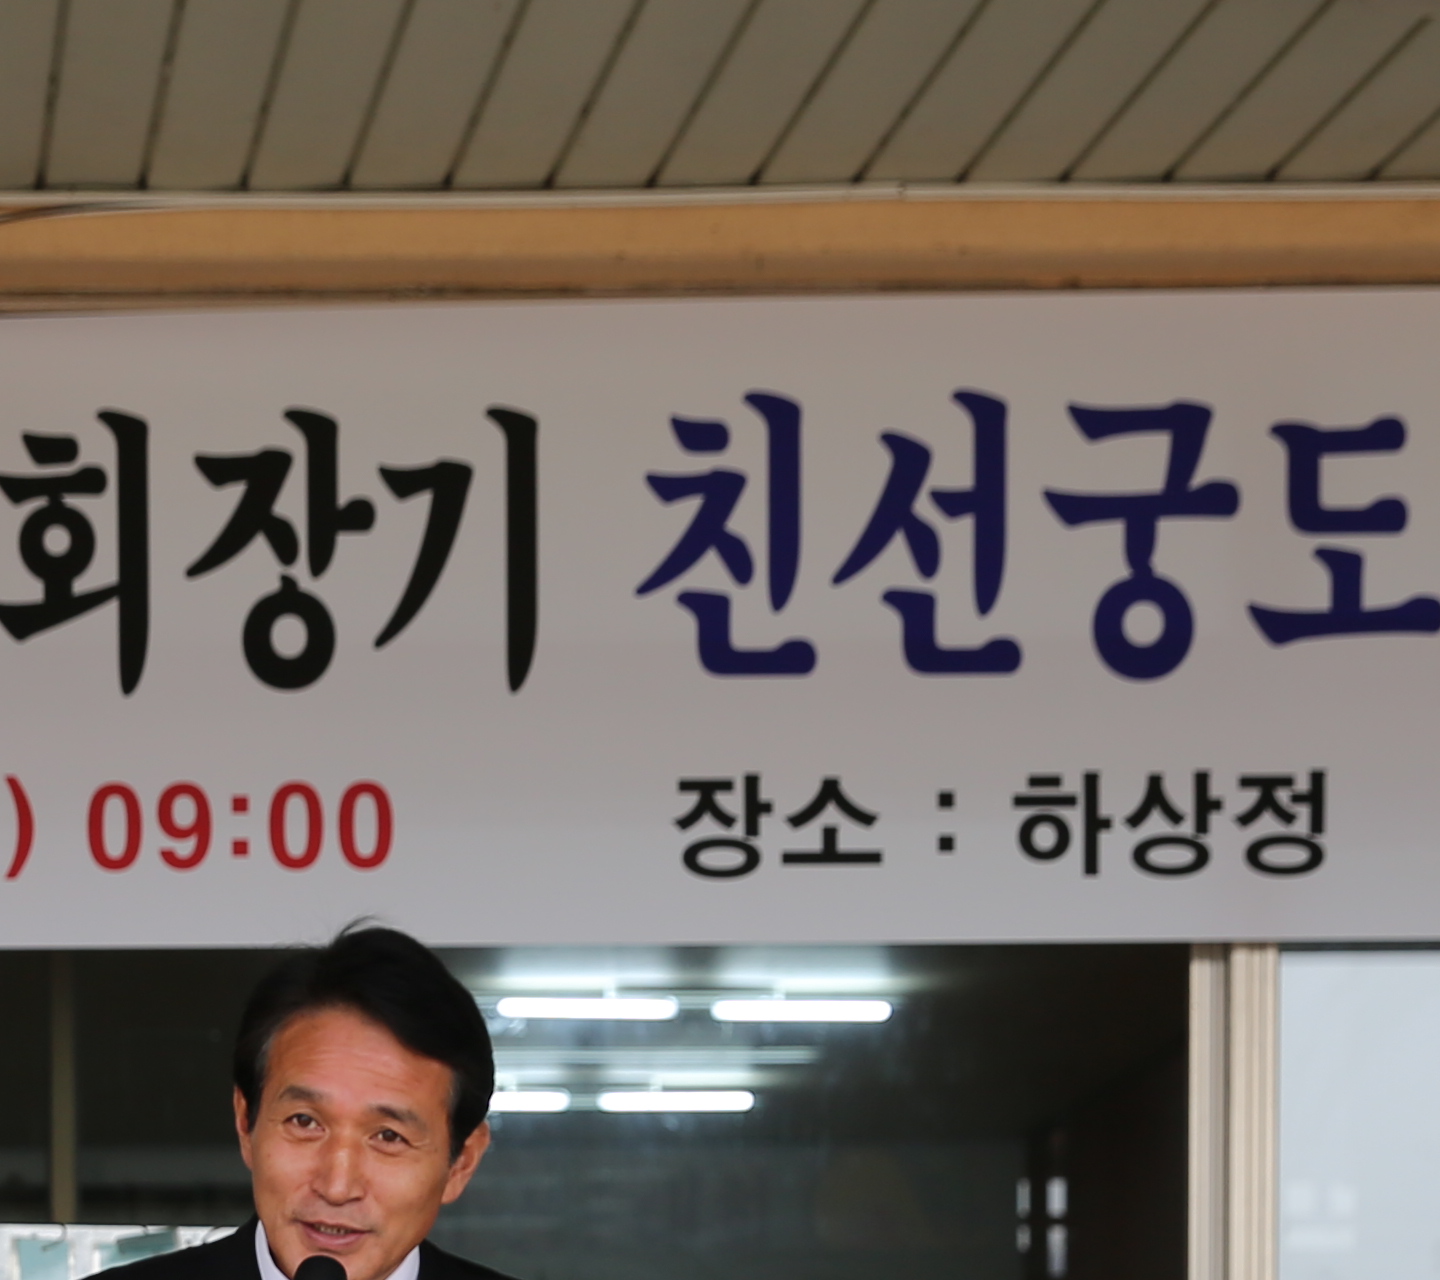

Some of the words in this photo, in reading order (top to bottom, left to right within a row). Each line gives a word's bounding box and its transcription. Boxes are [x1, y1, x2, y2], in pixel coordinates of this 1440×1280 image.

[85, 780, 395, 872] 09:00
[674, 772, 884, 880] 장소
[1011, 769, 1328, 878] 하상정
